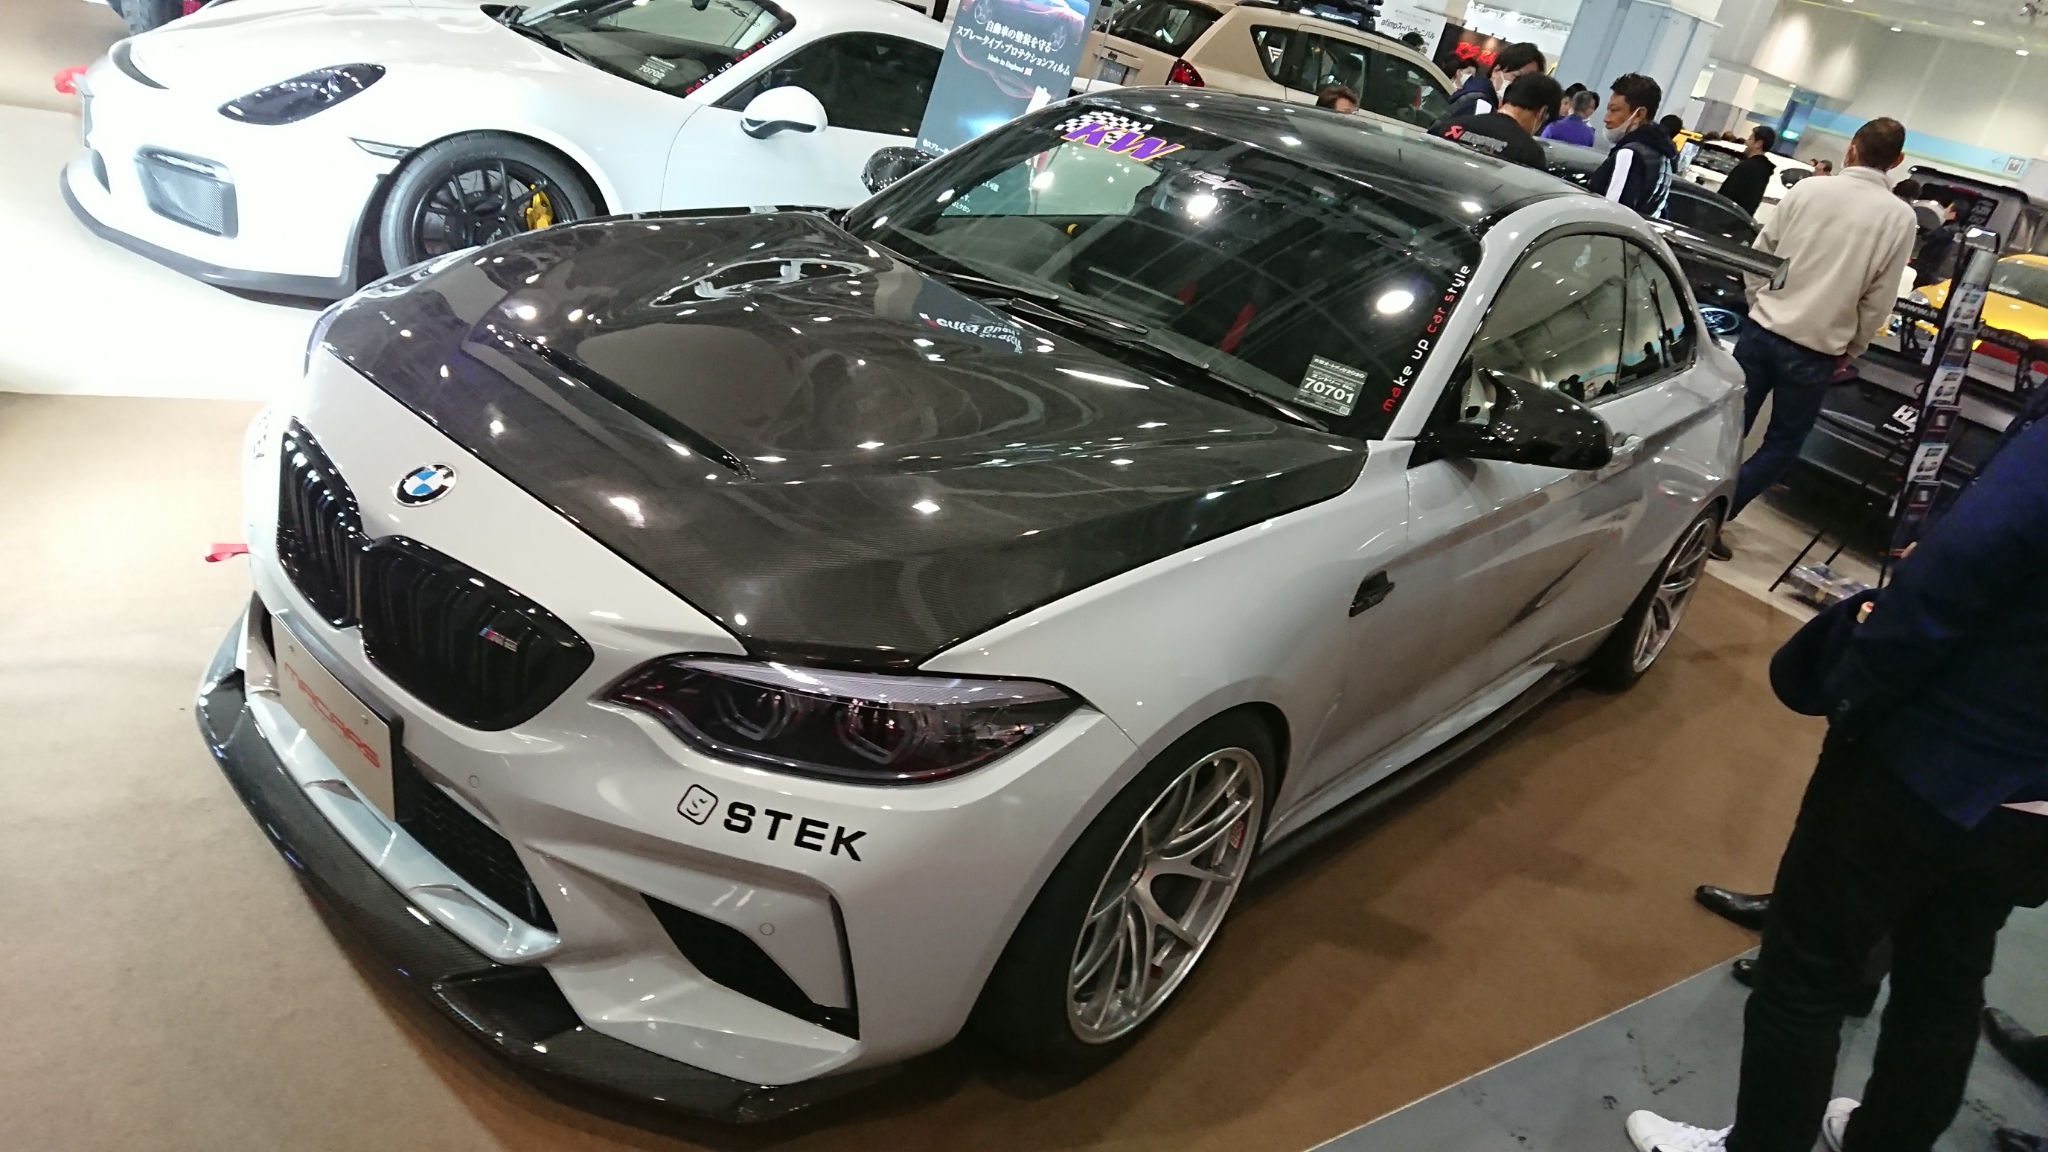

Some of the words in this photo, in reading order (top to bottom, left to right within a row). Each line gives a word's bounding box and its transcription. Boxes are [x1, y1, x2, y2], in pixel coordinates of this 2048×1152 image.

[717, 61, 733, 73] up
[1060, 121, 1186, 162] KW
[1382, 365, 1413, 412] make
[1411, 339, 1430, 360] up
[1427, 306, 1447, 333] car
[1444, 265, 1471, 302] style
[1303, 377, 1355, 404] 70701
[723, 801, 867, 862] STEK
